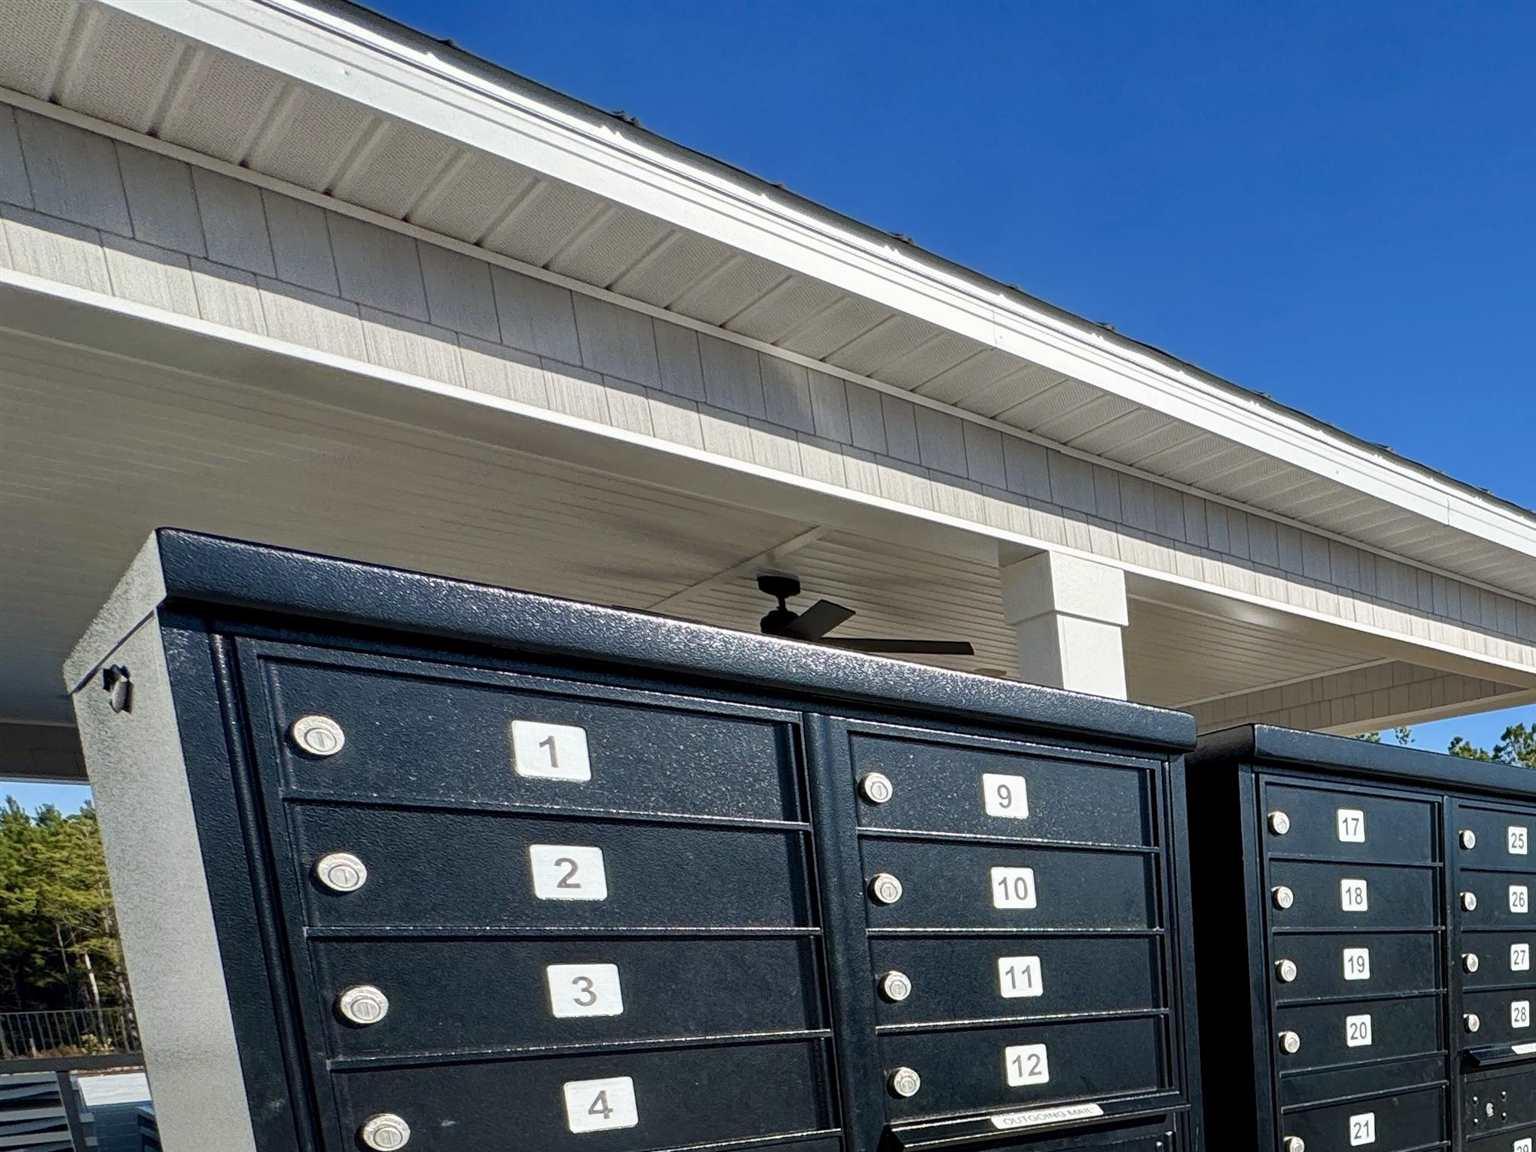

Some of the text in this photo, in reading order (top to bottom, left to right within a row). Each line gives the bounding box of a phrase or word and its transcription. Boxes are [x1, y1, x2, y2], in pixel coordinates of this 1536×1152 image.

[538, 735, 559, 768] 1
[997, 784, 1013, 810] 9
[1342, 817, 1360, 836] 17
[1511, 832, 1525, 850] 25
[554, 857, 581, 889] 2
[998, 876, 1028, 901] 10
[1345, 886, 1363, 905] 18
[1511, 891, 1526, 908] 26
[1348, 955, 1365, 974] 19
[1513, 949, 1526, 966] 27
[1005, 965, 1032, 990] 11
[572, 976, 597, 1007] 3
[1514, 1006, 1527, 1023] 28
[1350, 1021, 1368, 1041] 20
[1012, 1053, 1042, 1078] 12
[588, 1090, 613, 1120] 4
[1353, 1120, 1370, 1140] 21
